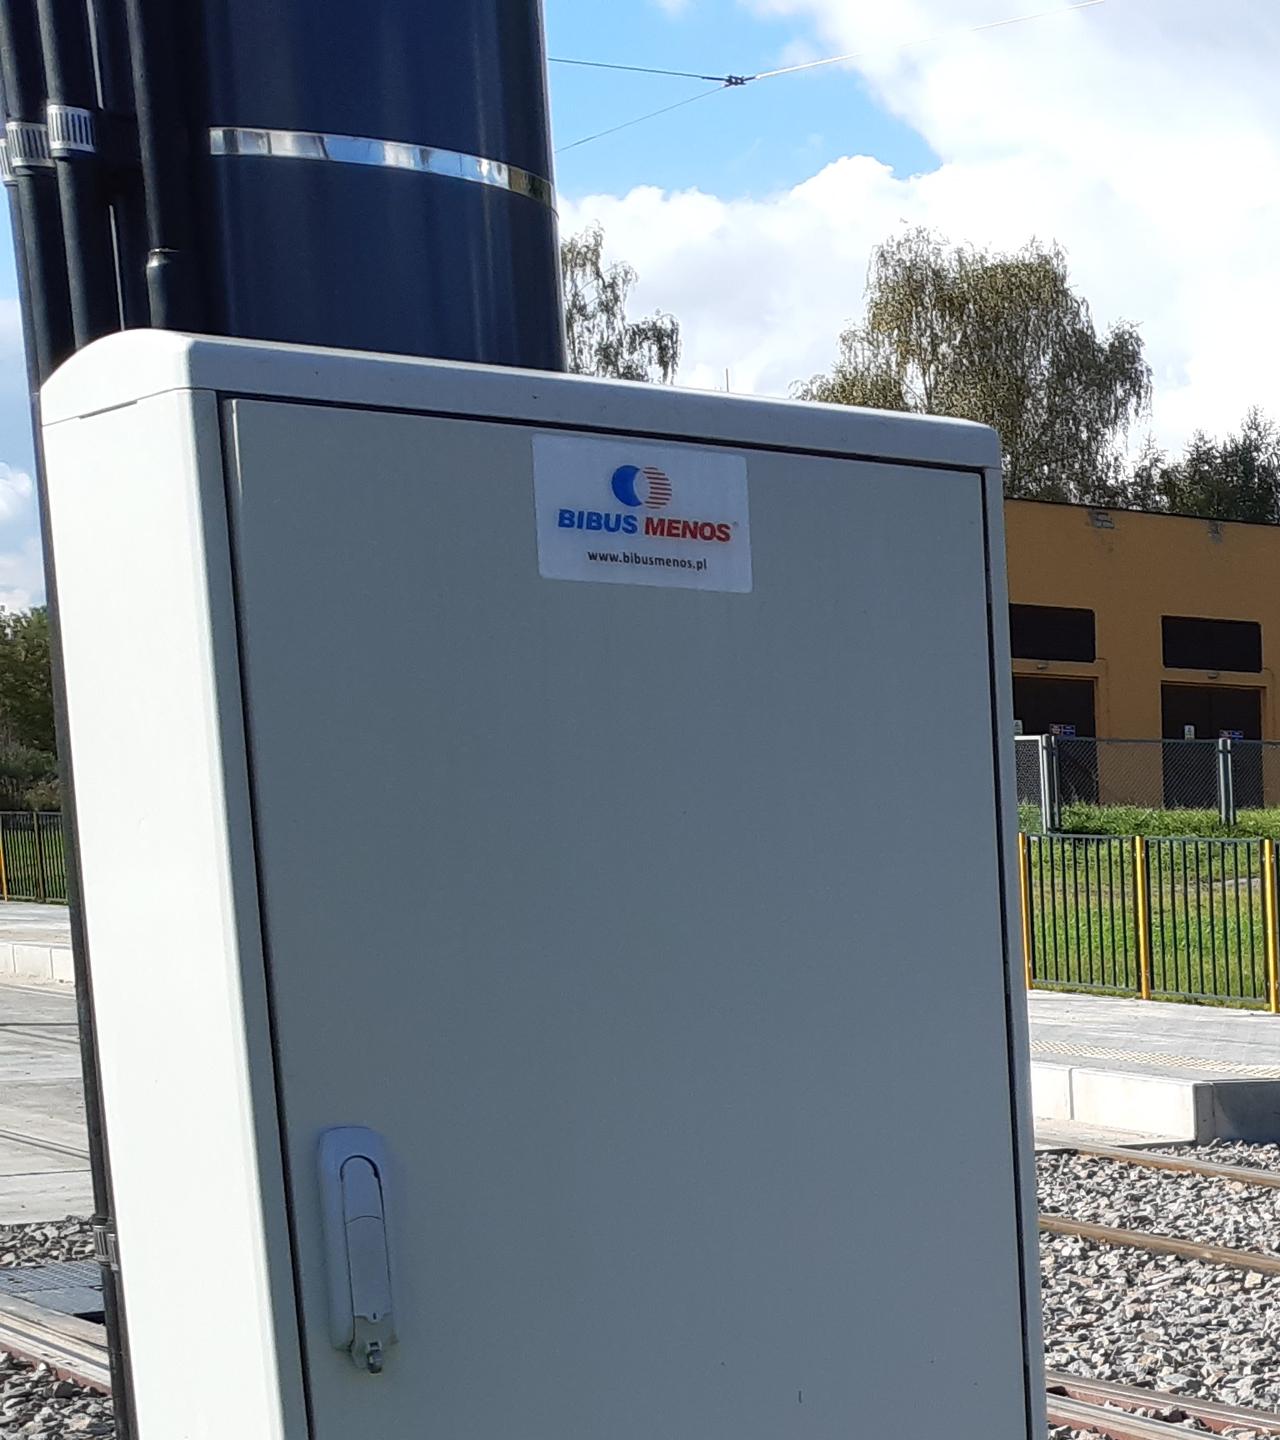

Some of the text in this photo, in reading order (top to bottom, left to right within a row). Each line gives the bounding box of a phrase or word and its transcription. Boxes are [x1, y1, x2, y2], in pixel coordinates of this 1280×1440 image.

[558, 509, 732, 543] BIBUS MENOS
[587, 551, 708, 571] www.bibusmenos.pl
